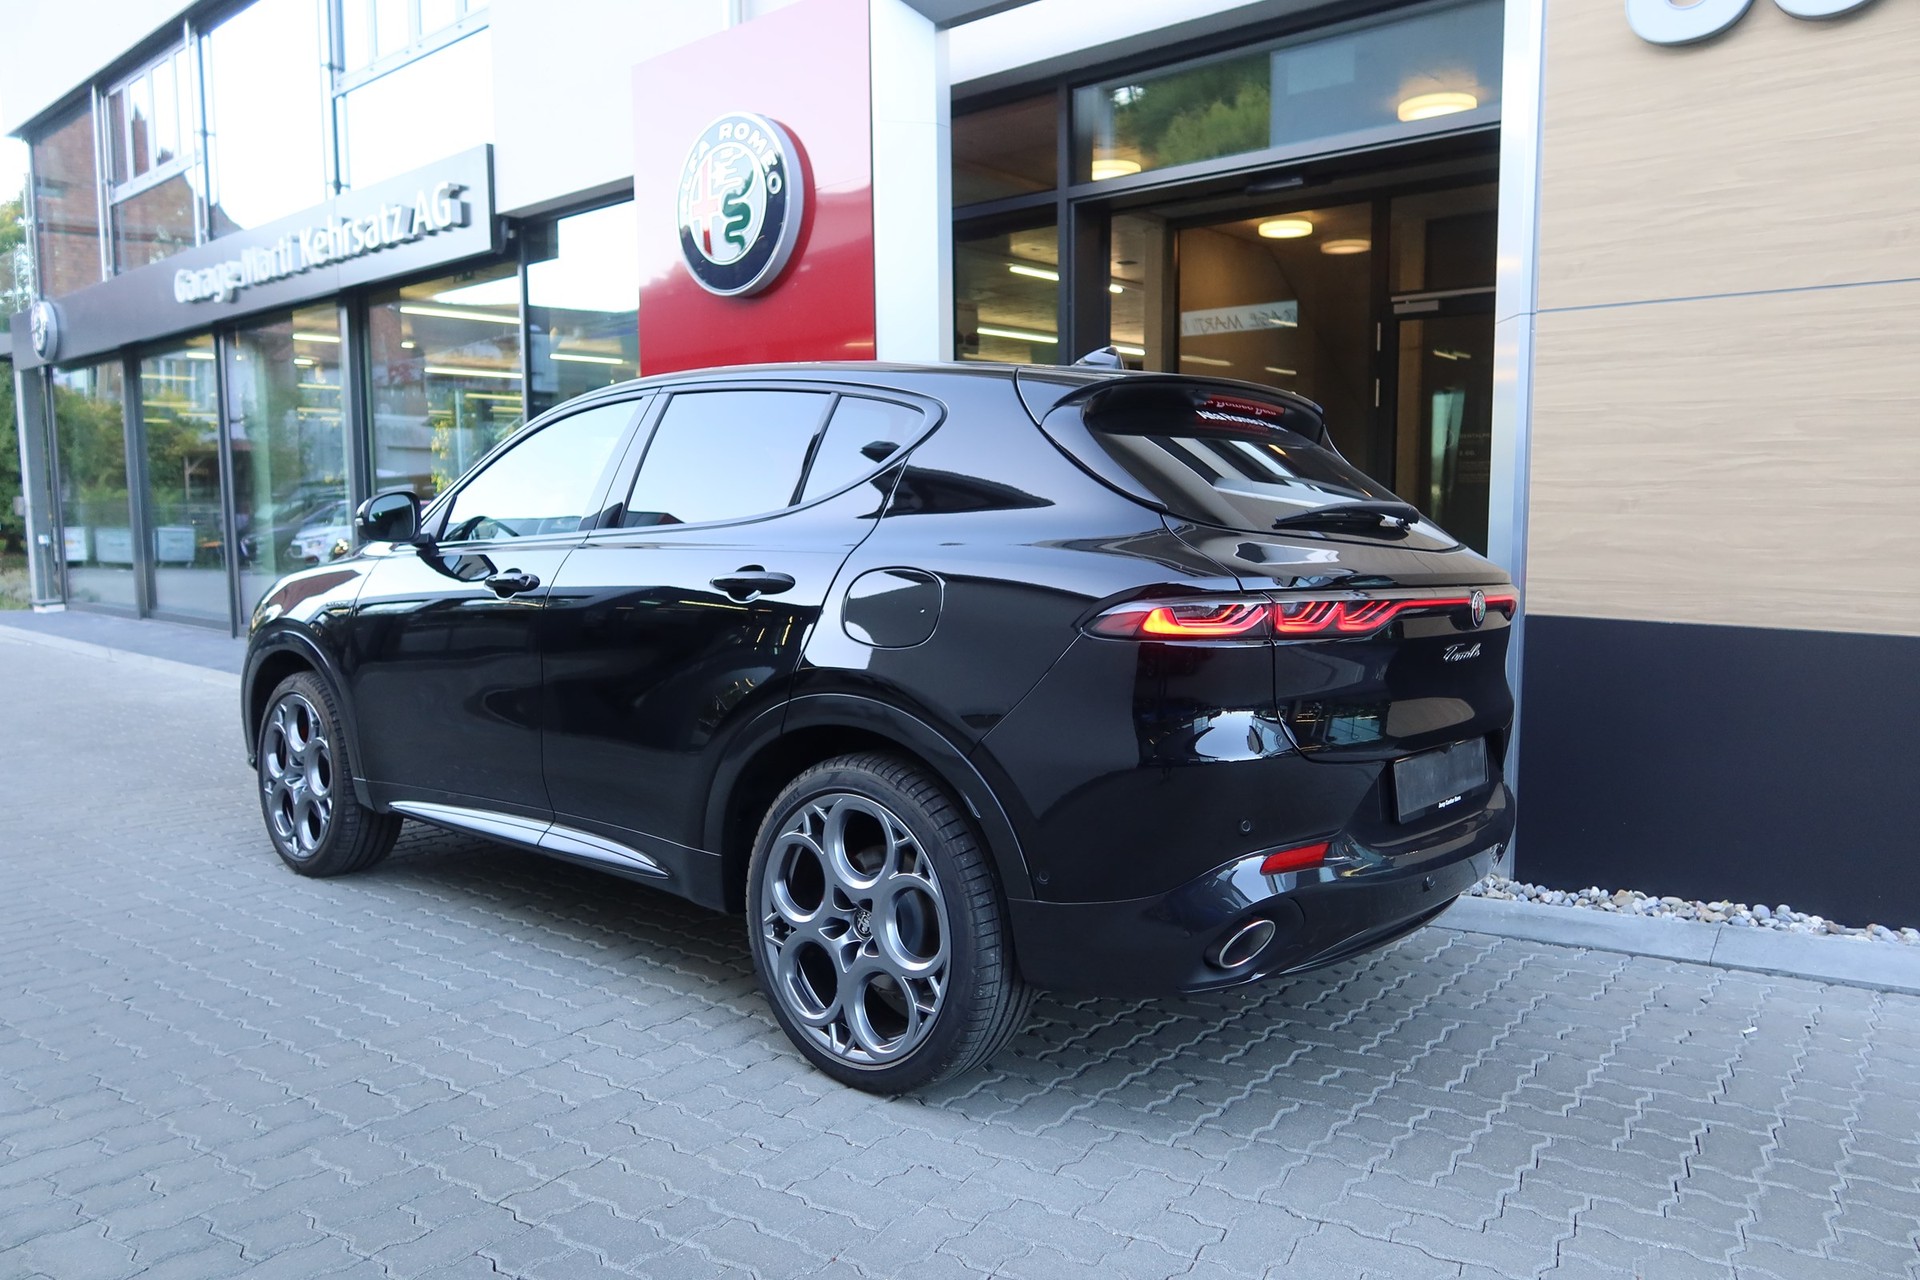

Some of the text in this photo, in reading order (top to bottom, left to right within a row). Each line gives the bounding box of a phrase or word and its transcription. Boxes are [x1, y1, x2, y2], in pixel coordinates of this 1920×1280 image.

[718, 122, 782, 195] ROMEO
[174, 181, 460, 303] Garage Marti Kehrsatz AG
